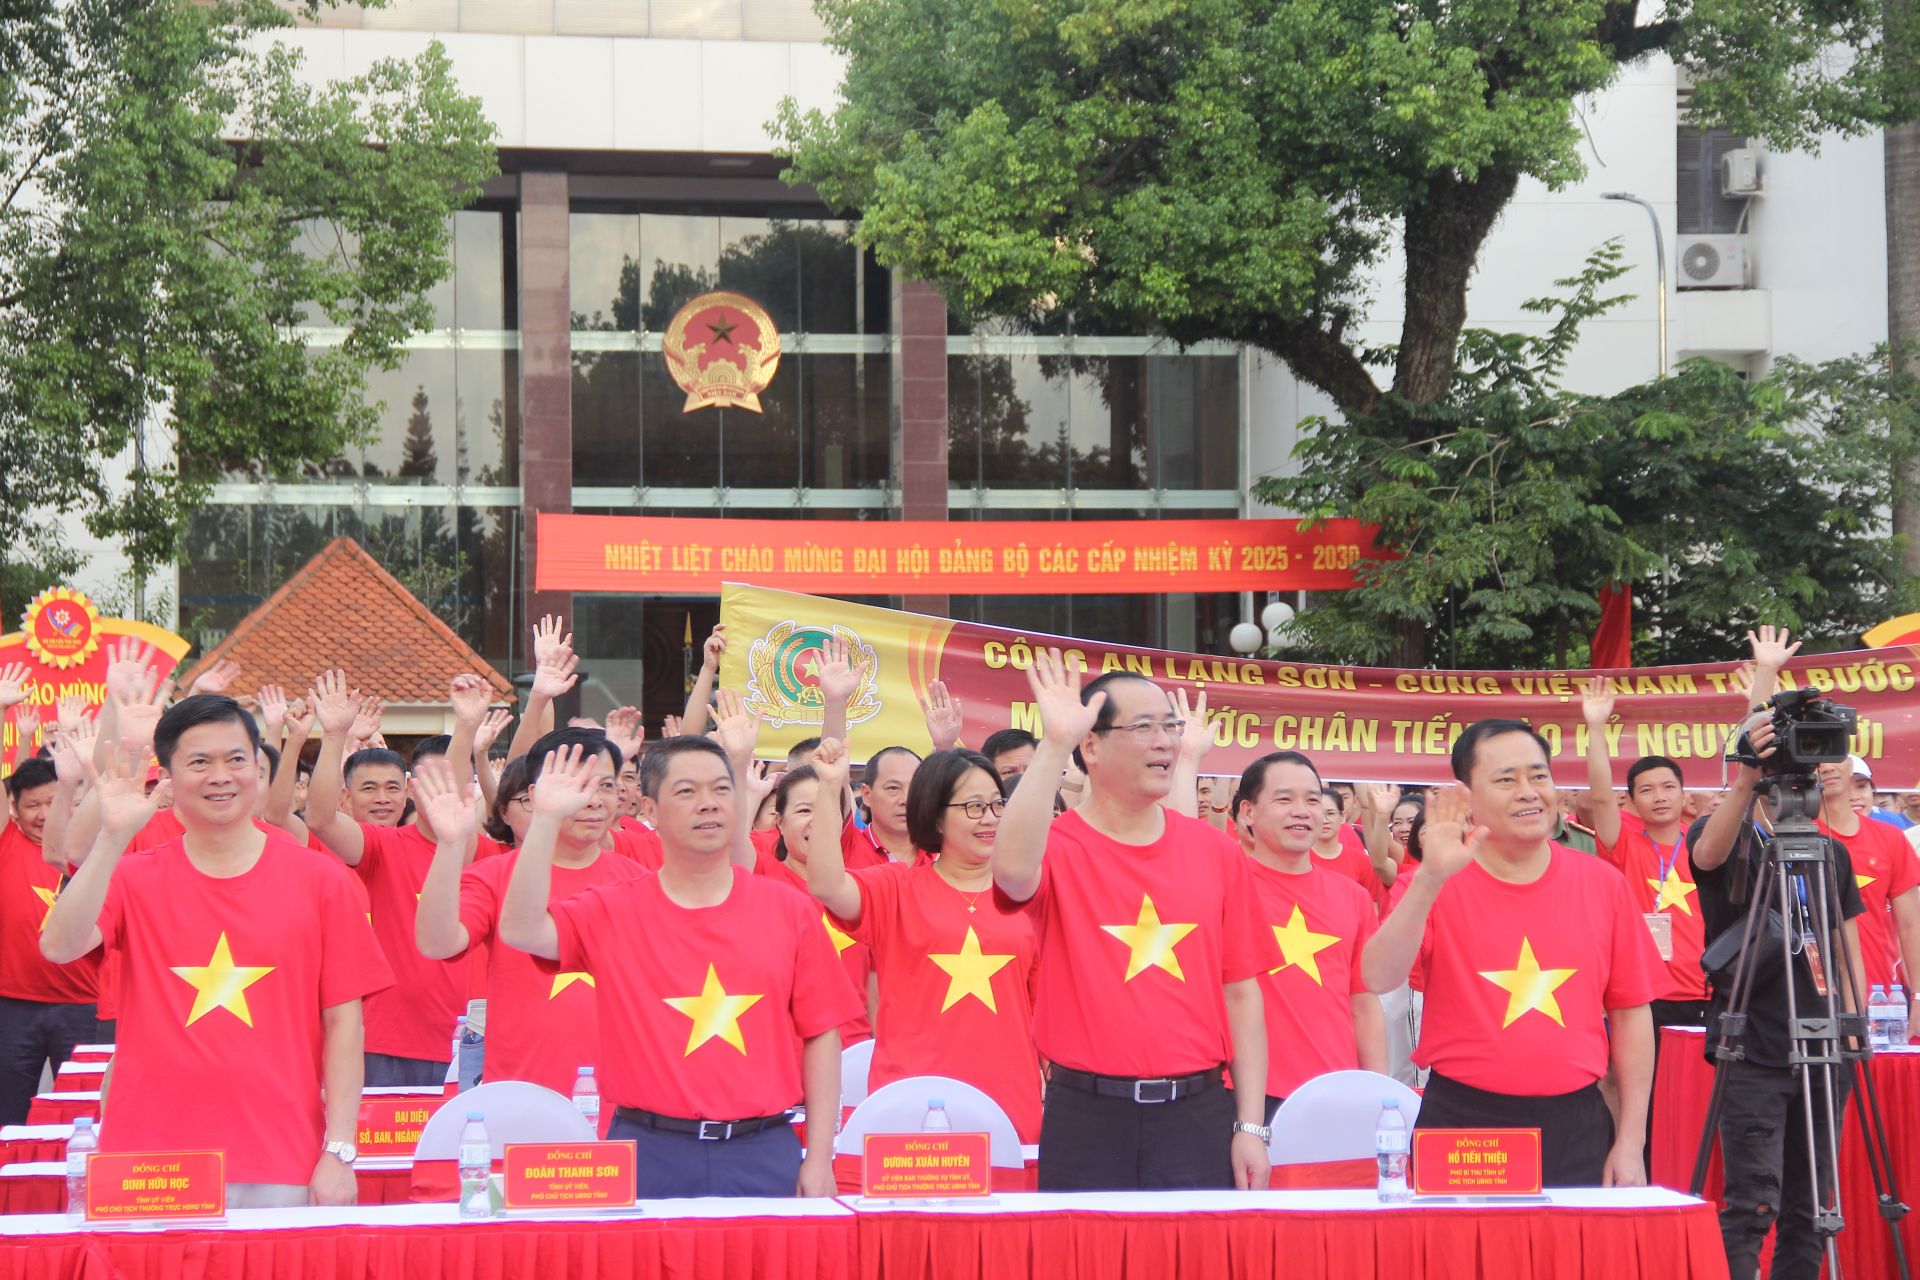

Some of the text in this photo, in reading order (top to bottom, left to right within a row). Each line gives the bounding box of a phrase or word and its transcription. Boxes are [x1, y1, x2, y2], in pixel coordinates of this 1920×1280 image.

[605, 538, 662, 575] NHIỆT
[672, 541, 712, 577] LIỆT
[721, 542, 774, 573] CHÀO
[784, 540, 843, 574] MỪNG
[854, 546, 886, 579] ĐẠI
[897, 543, 930, 579] HỘI
[940, 538, 993, 574] ĐẢNG
[1003, 541, 1029, 578] BỘ
[1039, 542, 1078, 574] CÁC
[1088, 539, 1127, 573] CẤP
[1134, 540, 1198, 576] NHIỆM
[1209, 540, 1233, 571] KỲ
[1241, 544, 1289, 571] 2025
[1313, 544, 1361, 571] 2030
[1101, 652, 1154, 677] AN
[1165, 657, 1265, 688] LẠNG
[1277, 666, 1357, 691] SƠN
[1394, 672, 1503, 695] CÙNG
[1511, 673, 1594, 703] VIỆT
[1606, 673, 1699, 695] NAM
[1705, 665, 1798, 694] TIN
[1807, 657, 1916, 693] BƯỚC
[1273, 711, 1380, 753] CHÂN
[1637, 722, 1741, 758] NGUY
[1849, 714, 1883, 759] ỚI
[395, 1108, 430, 1126] ĐẠI DIỆN
[374, 1131, 394, 1144] BAN,
[1456, 1137, 1499, 1148] ĐỒNG CHÍ
[905, 1140, 949, 1151] ĐỒNG CHÍ
[547, 1150, 592, 1160] ĐỒNG CHÍ
[883, 1156, 914, 1168] DƯƠNG
[915, 1154, 940, 1168] XUÂN
[1462, 1149, 1481, 1164] TIẾN
[1483, 1150, 1508, 1166] THIỆU
[132, 1162, 180, 1173] ĐỒNG CHÍ
[525, 1165, 619, 1179] ĐOÀN THANH SƠN
[122, 1176, 189, 1192] ĐINH HỮU HỌC
